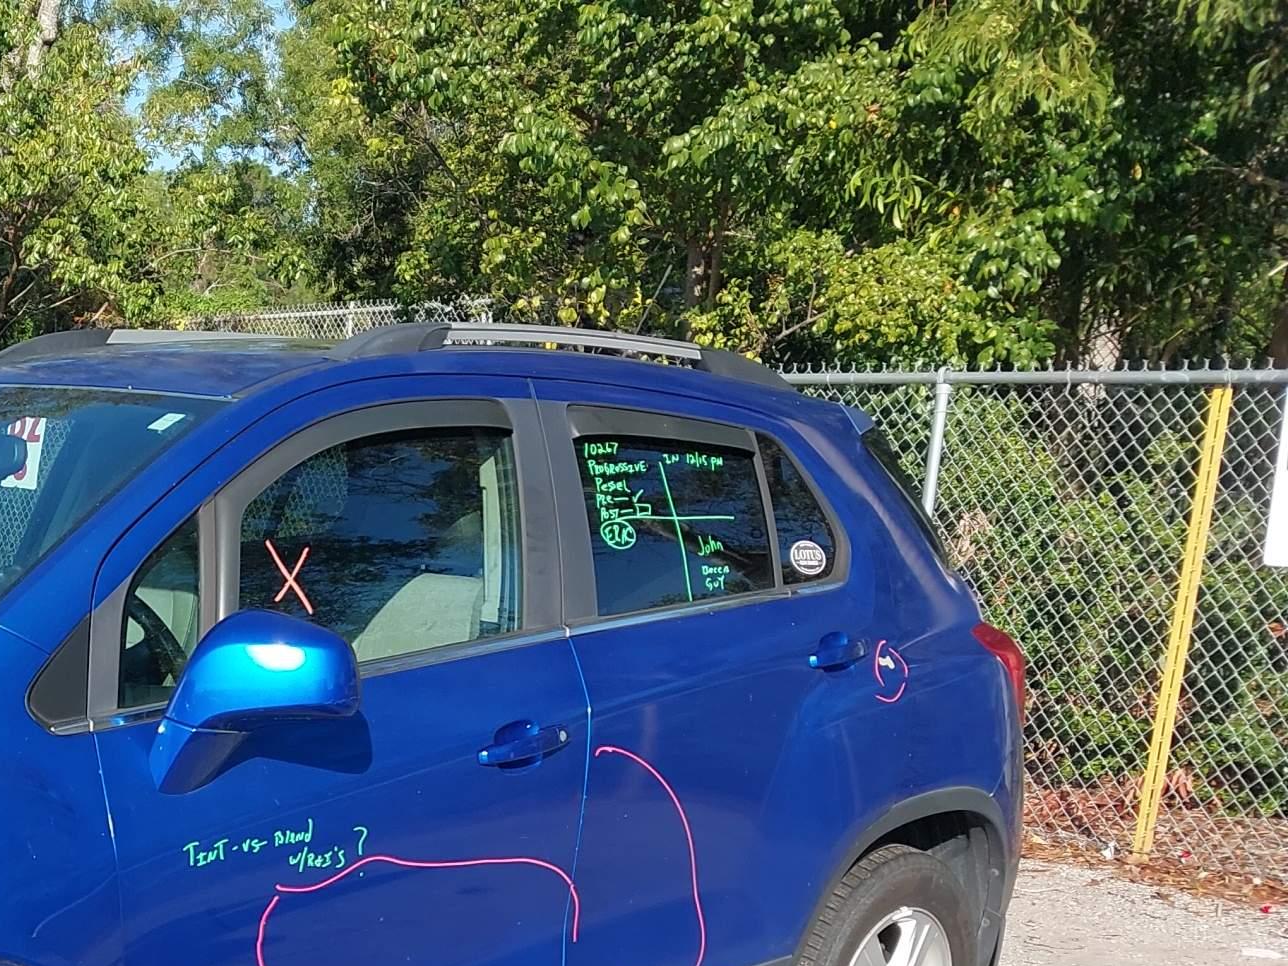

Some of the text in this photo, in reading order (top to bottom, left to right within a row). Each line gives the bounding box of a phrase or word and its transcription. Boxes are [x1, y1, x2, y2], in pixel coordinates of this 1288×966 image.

[584, 442, 619, 458] 10267
[697, 535, 724, 556] John
[794, 549, 822, 560] LOTUS
